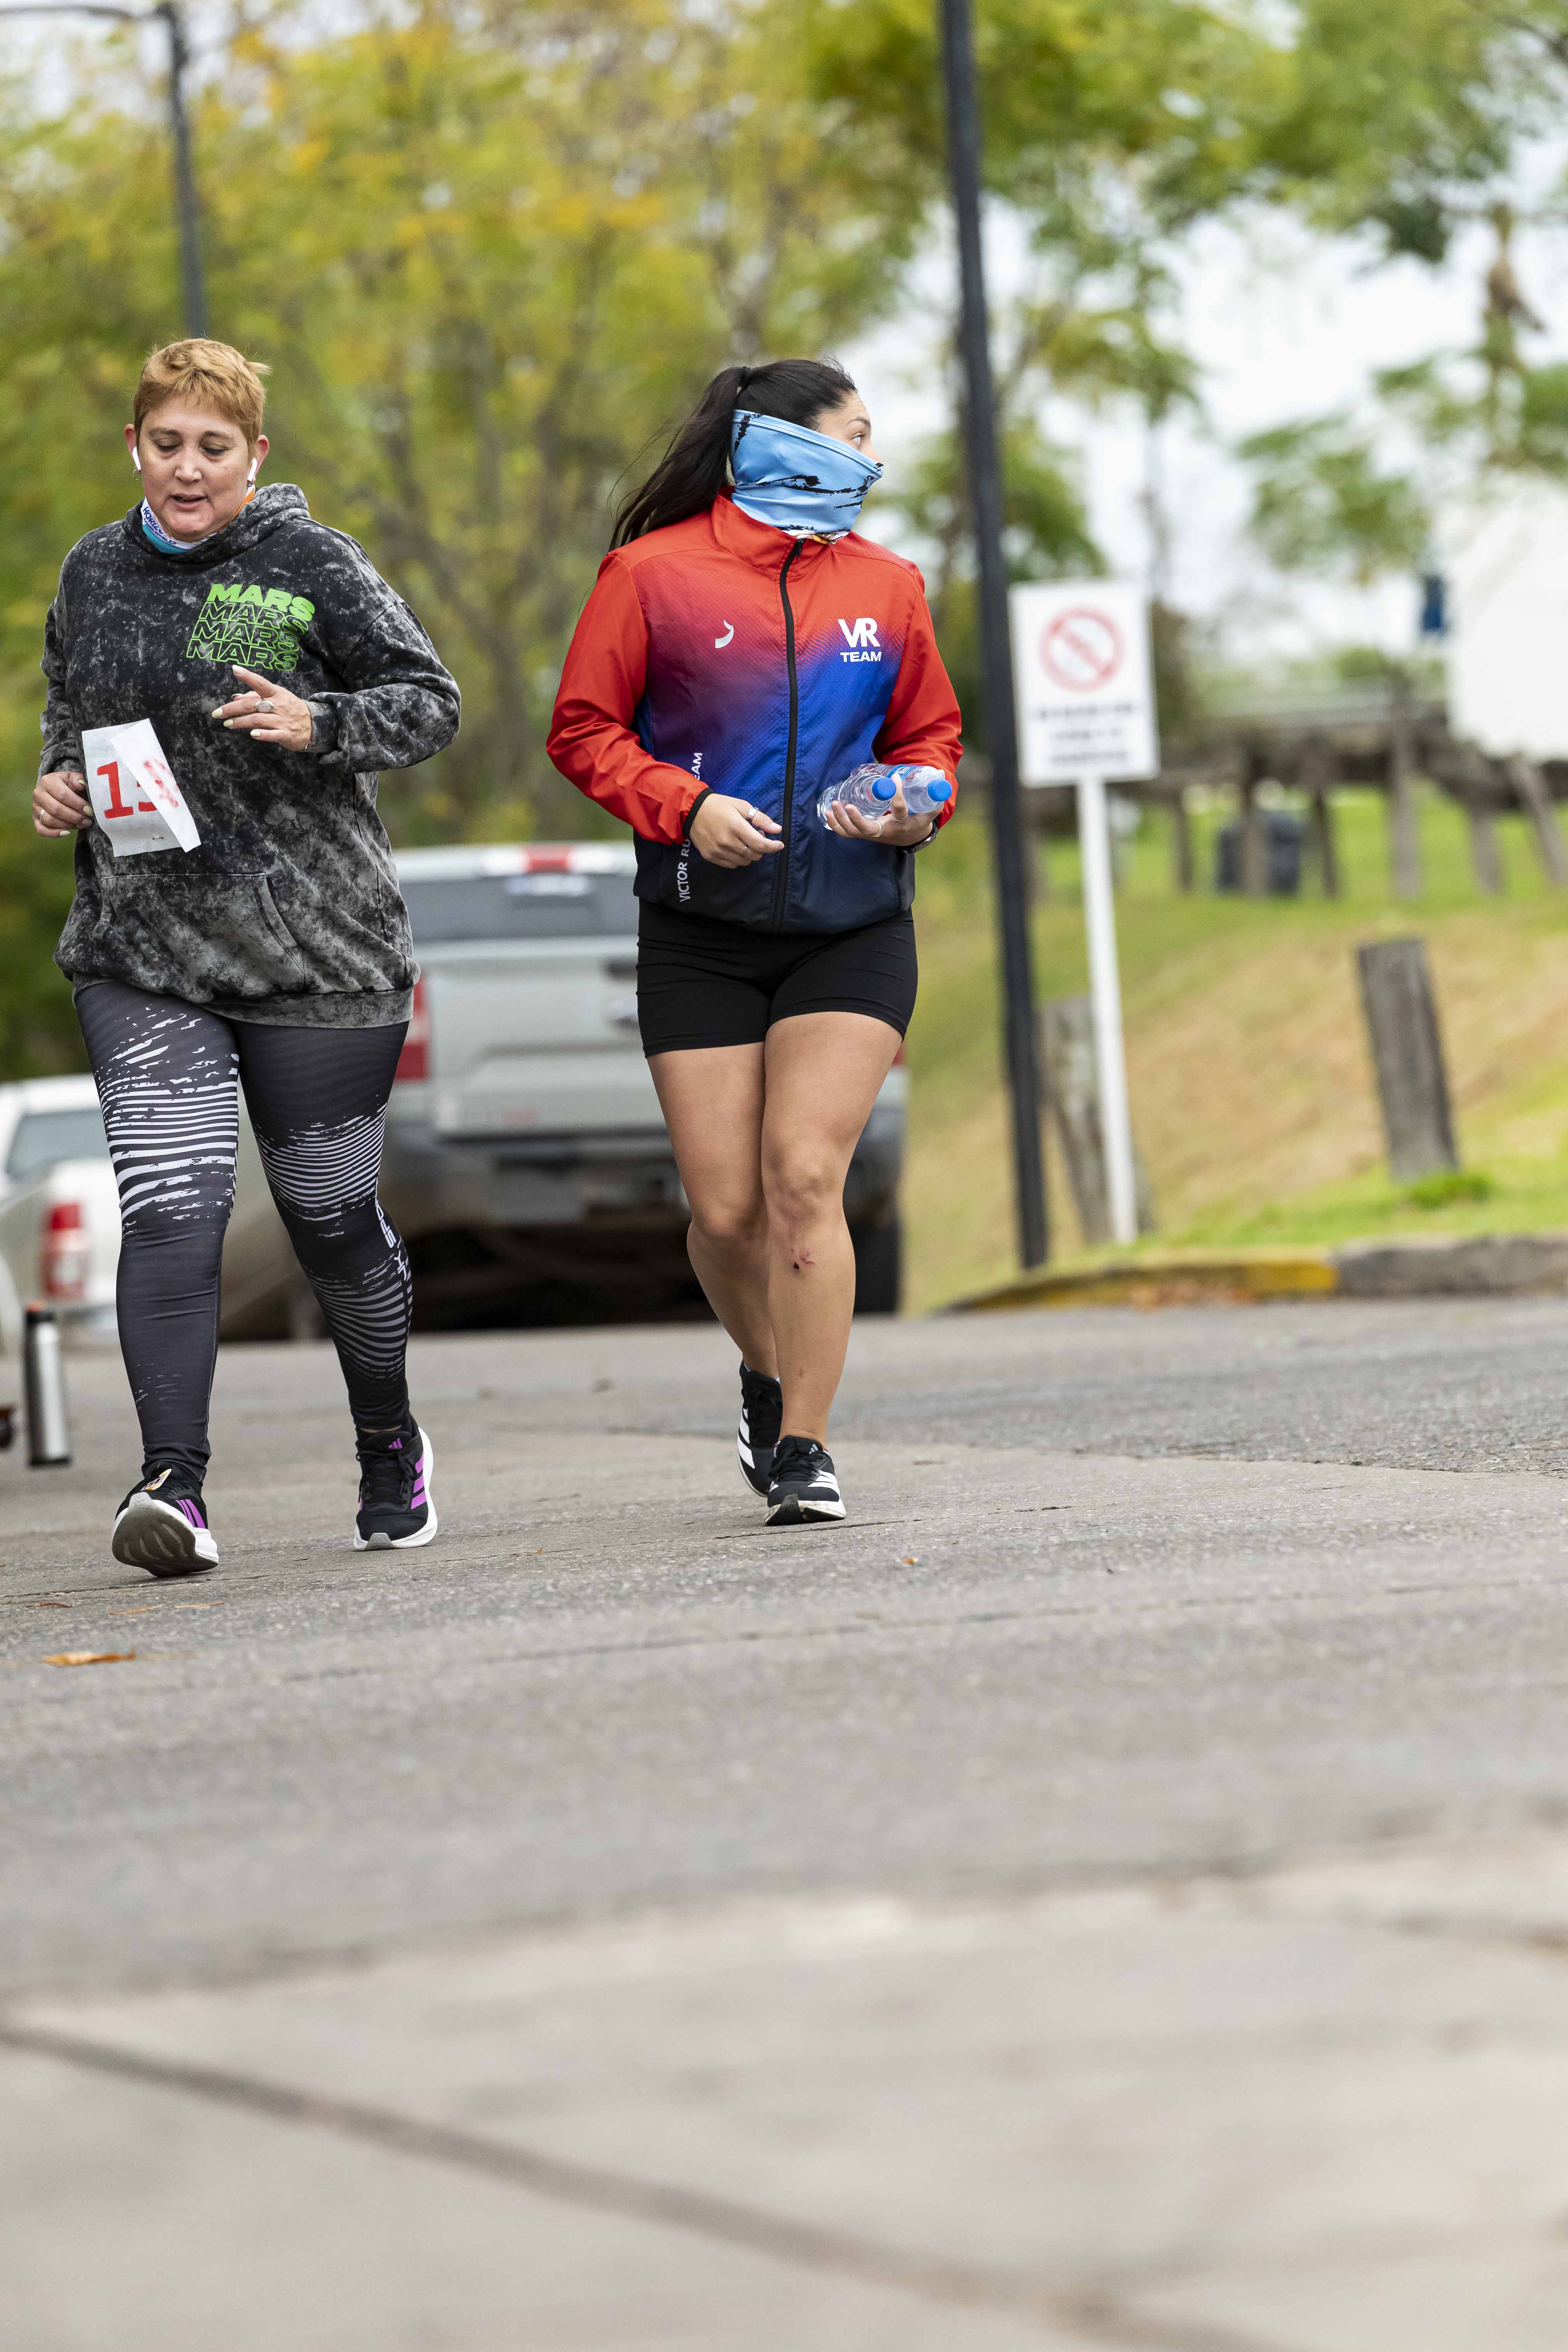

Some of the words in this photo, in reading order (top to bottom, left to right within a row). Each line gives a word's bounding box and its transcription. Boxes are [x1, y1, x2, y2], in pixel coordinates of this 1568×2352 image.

[199, 601, 308, 634] MARS
[206, 583, 315, 621] MARS
[192, 619, 299, 653] MARS
[837, 617, 880, 648] VR
[186, 638, 299, 671] MARS
[840, 651, 882, 662] TEAM
[677, 862, 691, 902] VICTOR
